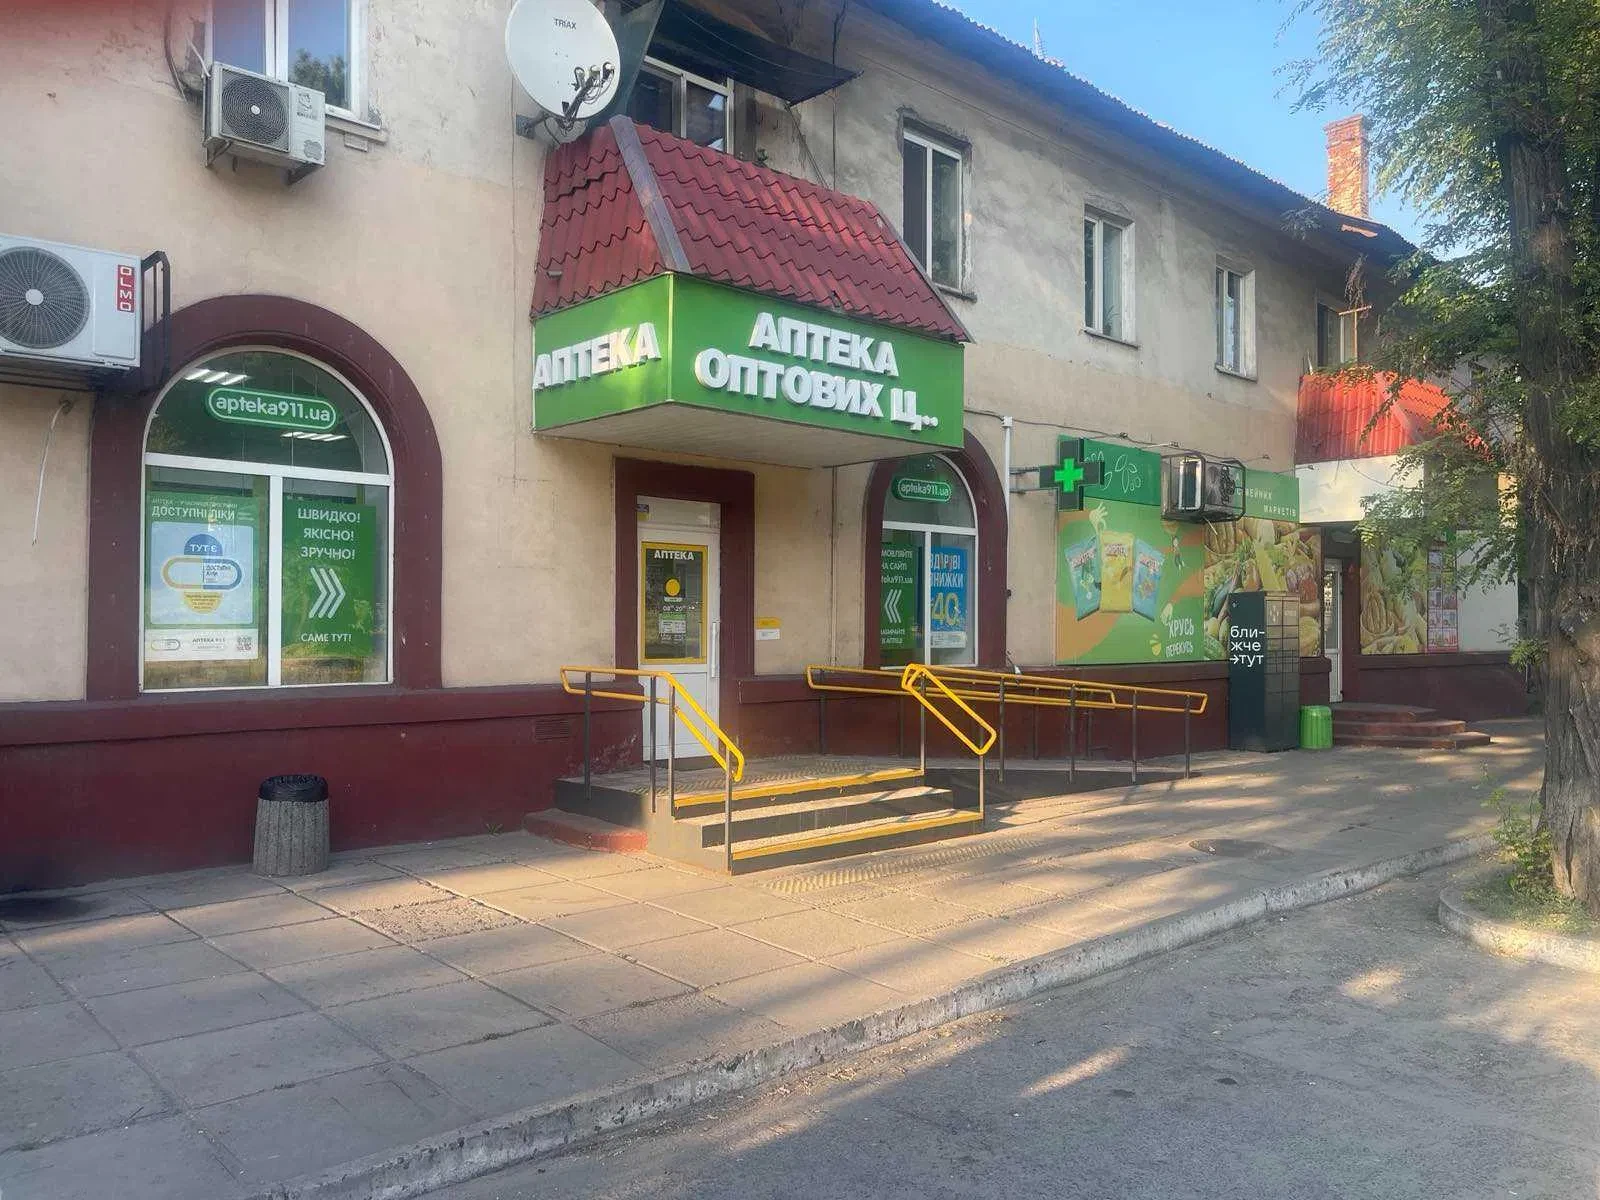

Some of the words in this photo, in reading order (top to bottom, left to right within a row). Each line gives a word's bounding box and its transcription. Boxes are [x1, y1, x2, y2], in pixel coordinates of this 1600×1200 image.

[553, 17, 577, 30] TRIAX
[120, 266, 132, 311] OLMO
[749, 312, 899, 377] АПТЕКА
[532, 322, 662, 391] АПТЕКА
[694, 348, 884, 418] ОПТОВИХ
[216, 397, 331, 421] apteka911.ua
[900, 483, 949, 497] apteka911.ua
[152, 506, 207, 518] ДОСТУПНІ
[297, 508, 360, 523] ШВИДКО!
[303, 527, 354, 541] ЯКІСНО!
[189, 544, 209, 553] ТУТ
[301, 546, 356, 560] ЗРУЧНО!
[654, 550, 695, 560] АПТЕКА
[1168, 617, 1195, 639] ХРУСЬ
[1230, 625, 1265, 638] бли-
[301, 633, 329, 642] САМЕ
[331, 633, 352, 642] ТУТ!
[1230, 641, 1262, 652] жче
[1239, 654, 1264, 667] тут
